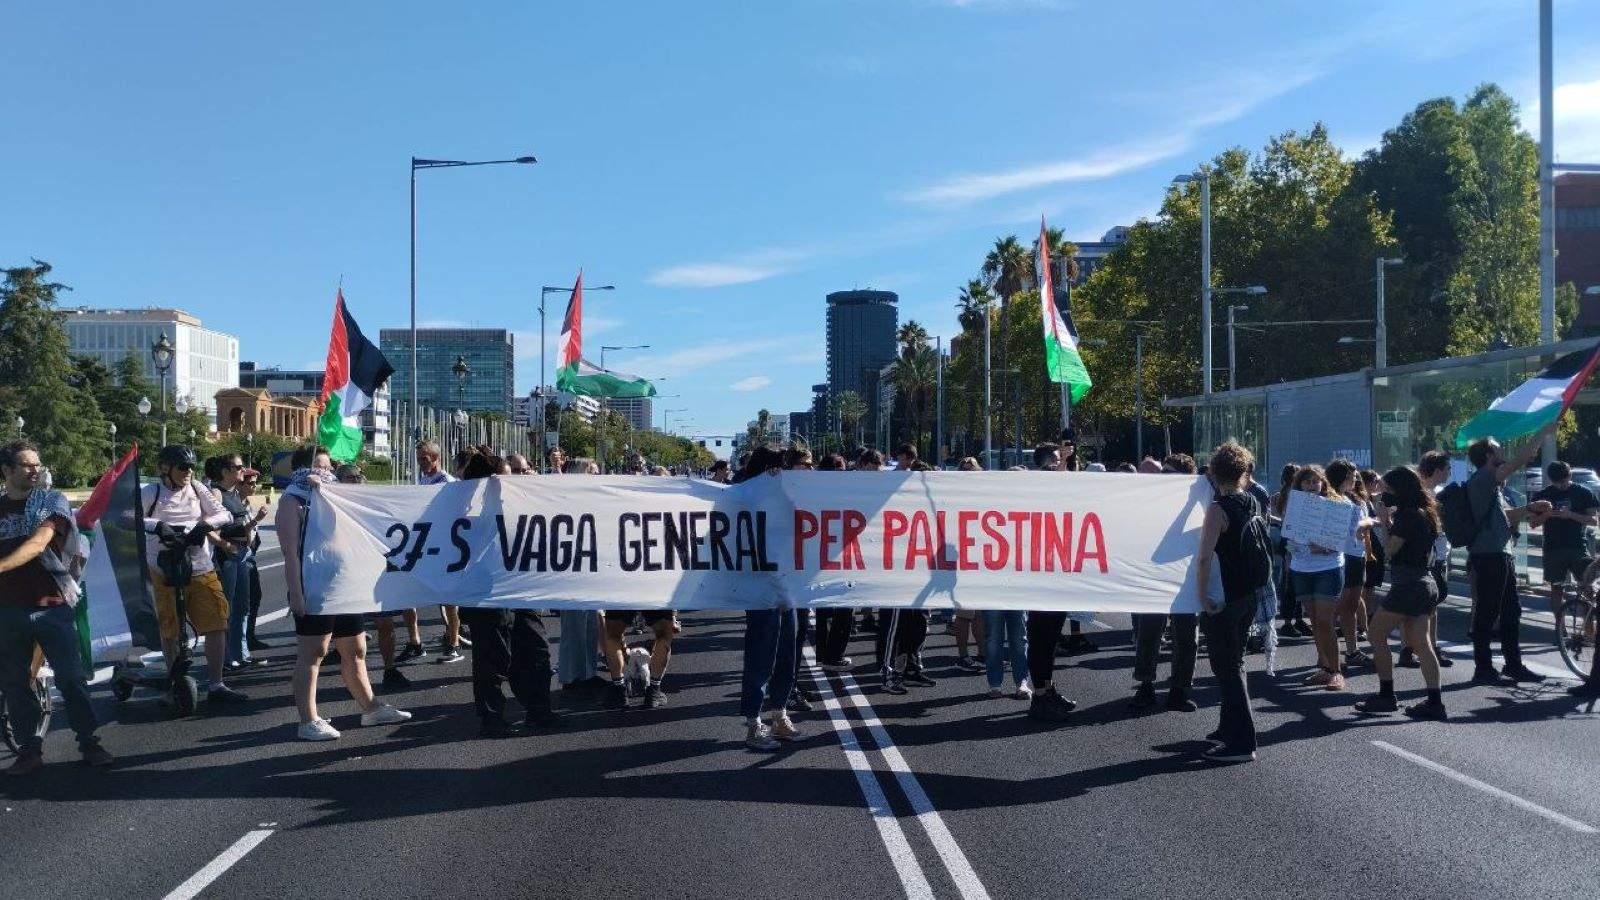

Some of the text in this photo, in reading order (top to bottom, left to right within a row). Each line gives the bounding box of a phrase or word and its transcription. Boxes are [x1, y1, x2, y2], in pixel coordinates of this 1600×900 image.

[495, 513, 598, 573] VAGA
[618, 510, 778, 573] GENERAL
[793, 509, 867, 571] PER
[882, 509, 1110, 574] PALESTINA
